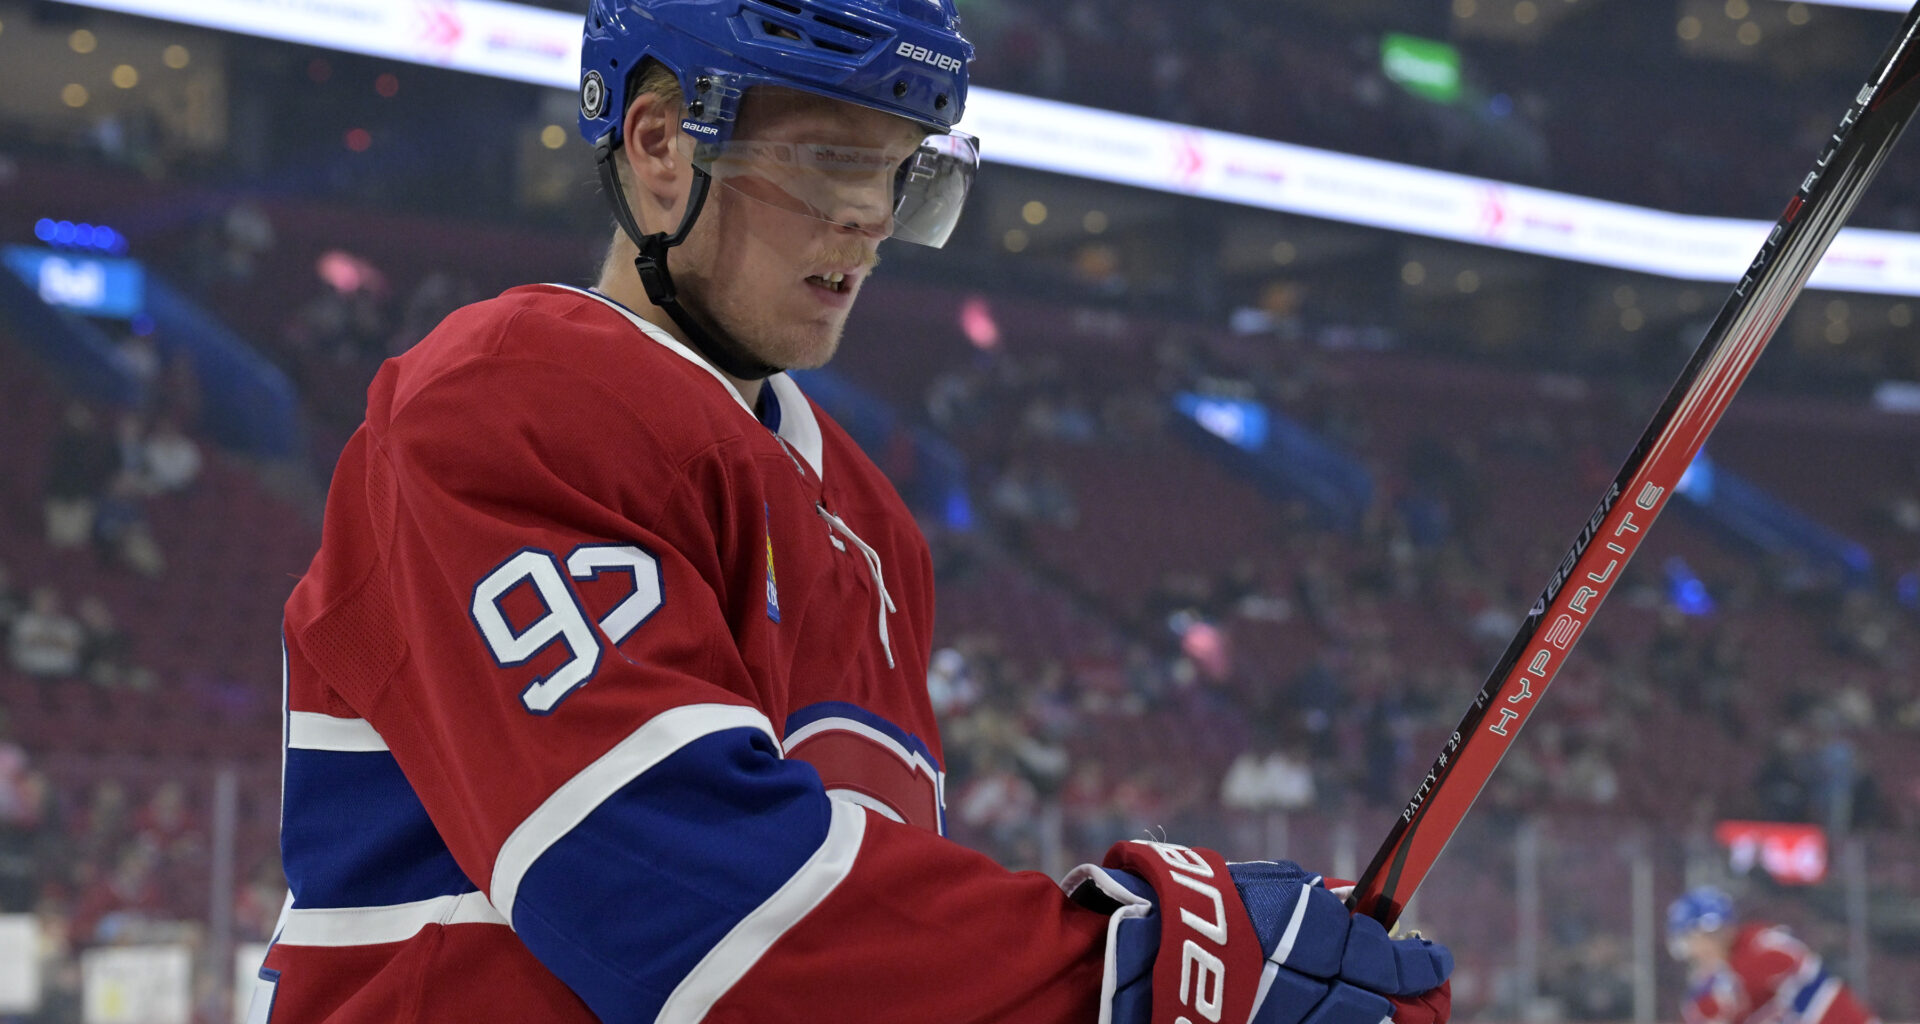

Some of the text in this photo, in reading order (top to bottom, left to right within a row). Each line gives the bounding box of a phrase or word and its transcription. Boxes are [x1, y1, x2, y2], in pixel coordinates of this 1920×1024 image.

[468, 541, 667, 716] 92
[1402, 731, 1461, 823] PATTY # 29
